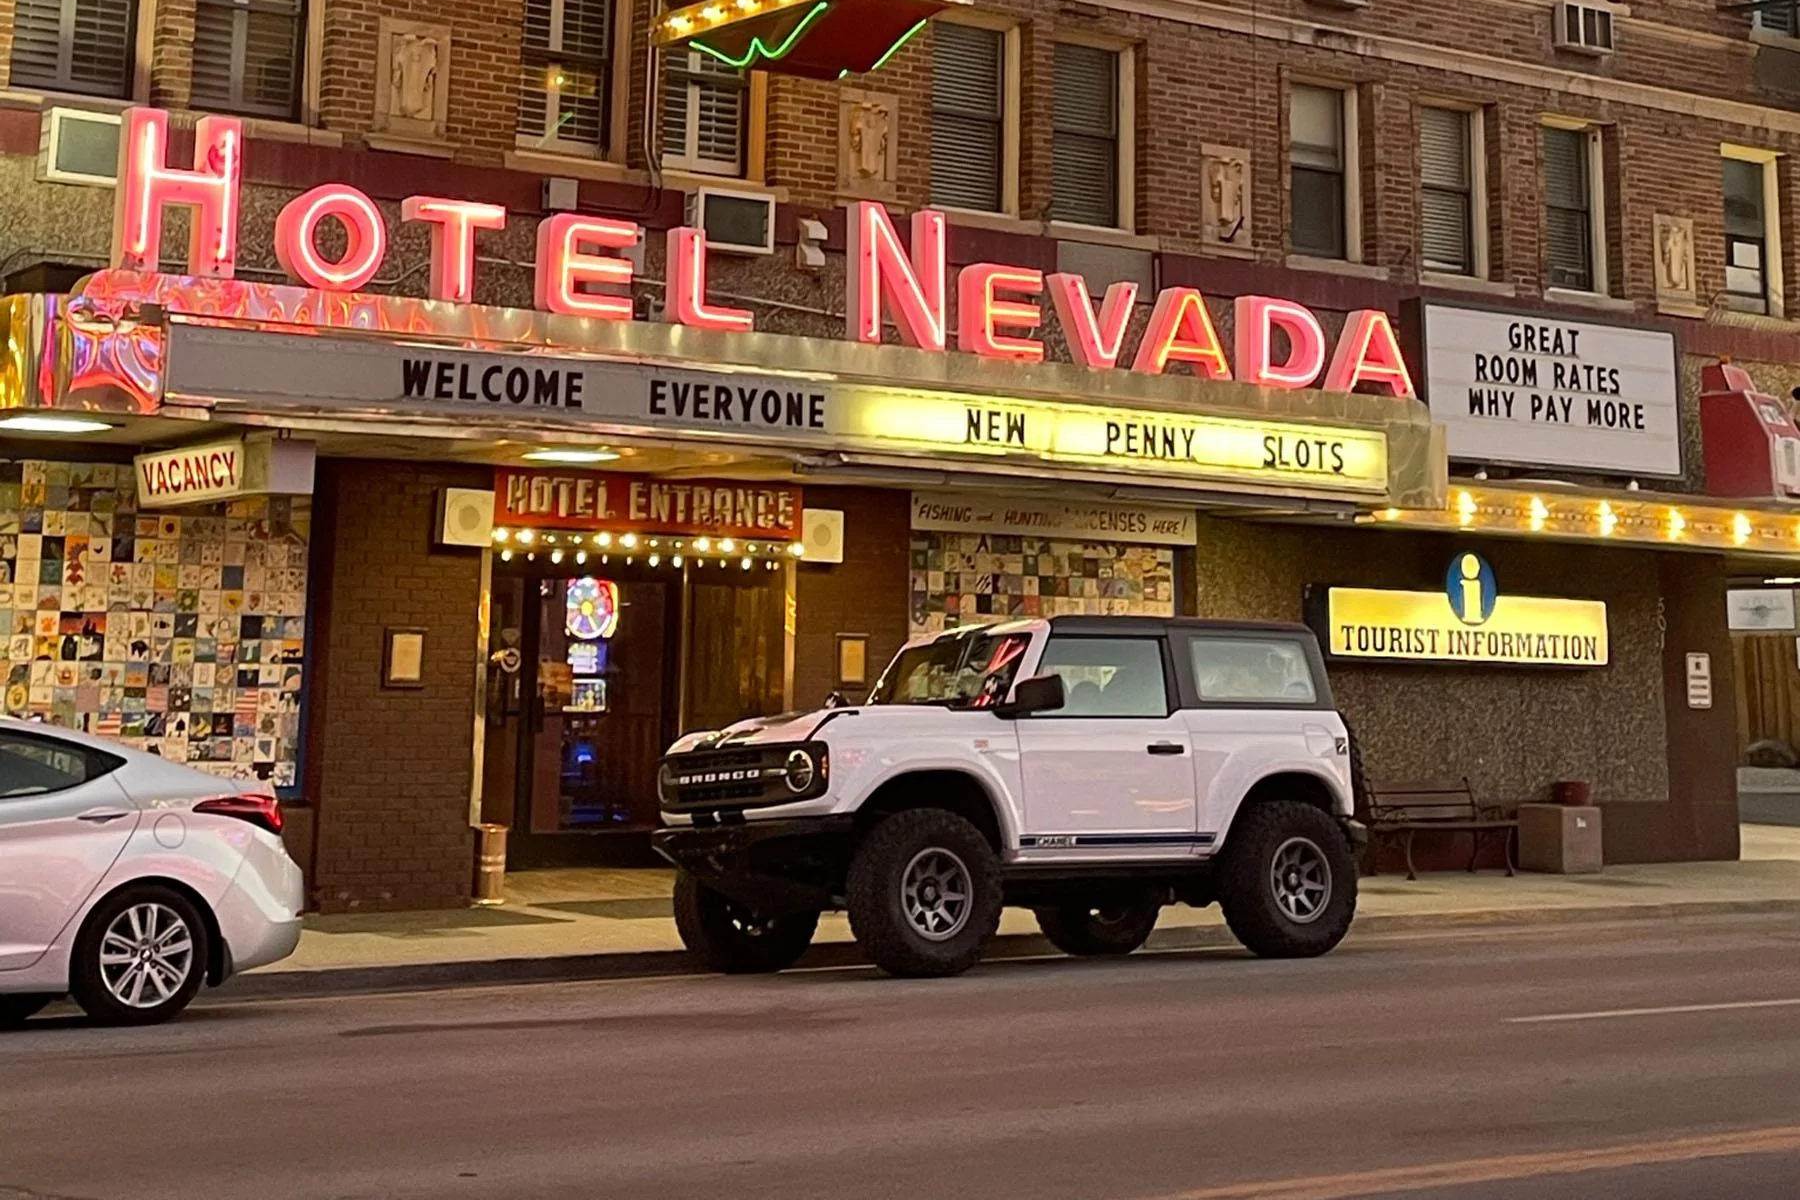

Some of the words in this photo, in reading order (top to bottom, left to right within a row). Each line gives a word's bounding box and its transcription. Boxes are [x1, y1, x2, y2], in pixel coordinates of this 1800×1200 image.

[110, 106, 755, 332] HOTEL
[846, 200, 1418, 399] NEVADA
[1508, 322, 1580, 356] GREAT
[1475, 353, 1537, 387] ROOM
[1553, 362, 1620, 395] RATES
[402, 359, 584, 408] WELCOME
[649, 379, 825, 428] EVERYONE
[966, 408, 1026, 445] NEW
[1105, 421, 1196, 459] PENNY
[1263, 435, 1345, 473] SLOTS
[1468, 387, 1515, 418] WHY
[1531, 393, 1574, 424] PAY
[1587, 400, 1645, 430] MORE
[142, 451, 236, 497] VACANCY
[507, 474, 615, 520] HOTEL
[629, 481, 794, 530] ENTRANCE
[918, 504, 973, 523] FISHING
[1152, 515, 1188, 536] HERE!
[1340, 625, 1440, 655] TOURIST
[1448, 629, 1598, 661] INFORMATION
[679, 769, 760, 785] BRONCO
